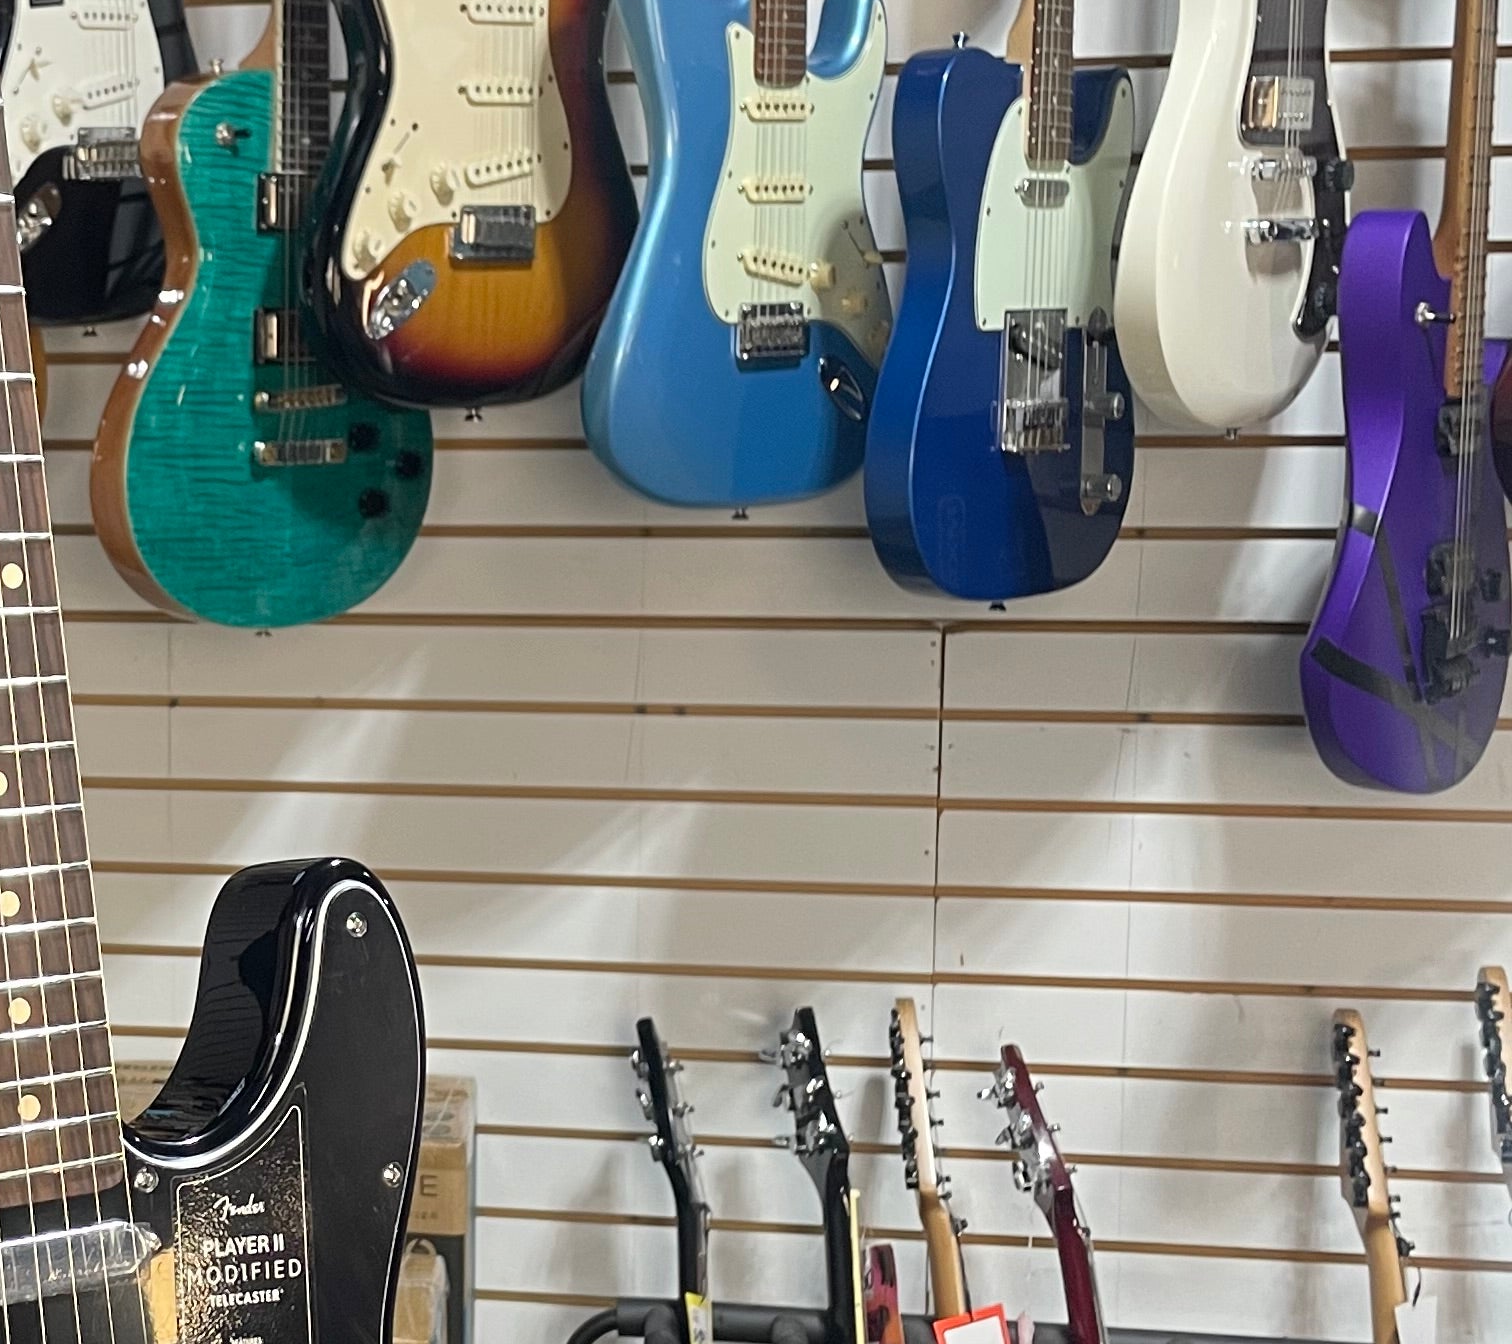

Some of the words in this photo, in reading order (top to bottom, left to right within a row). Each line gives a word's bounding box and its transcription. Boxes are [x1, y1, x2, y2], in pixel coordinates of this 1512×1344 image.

[212, 1193, 266, 1221] Fender
[202, 1234, 270, 1258] PLAYER
[187, 1258, 301, 1292] MODIFIED
[209, 1288, 281, 1309] TELECASTER
